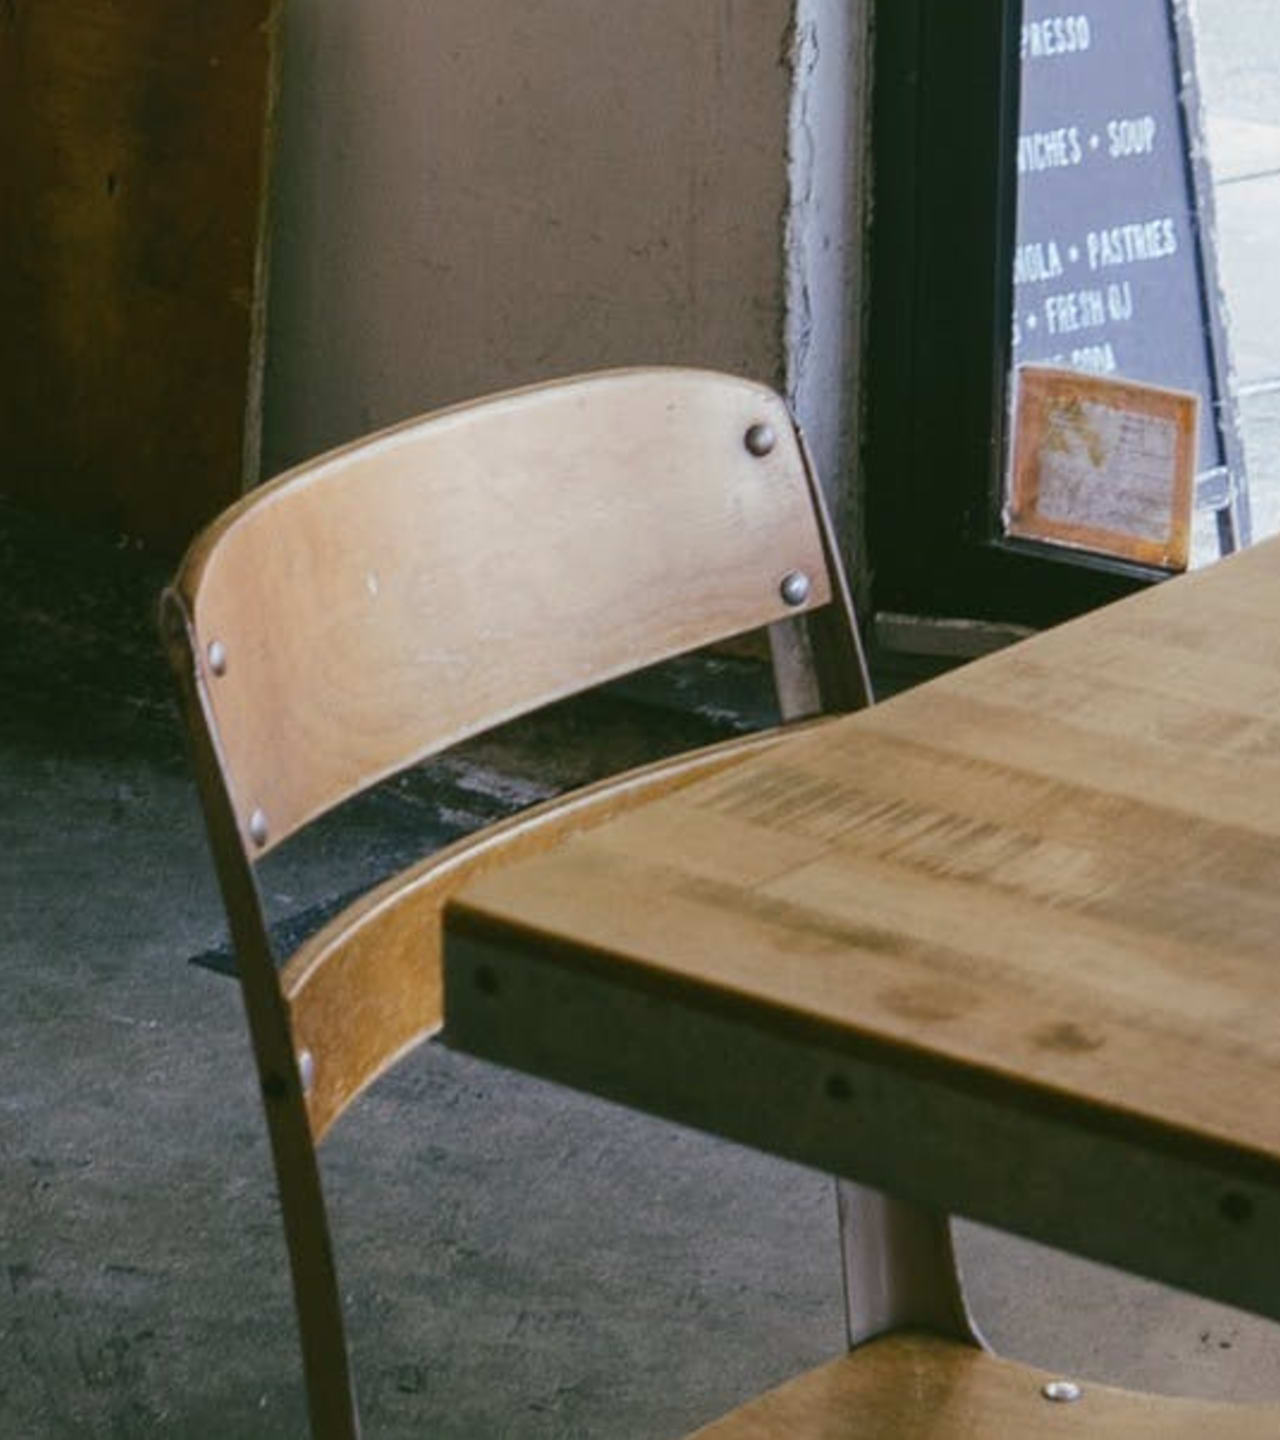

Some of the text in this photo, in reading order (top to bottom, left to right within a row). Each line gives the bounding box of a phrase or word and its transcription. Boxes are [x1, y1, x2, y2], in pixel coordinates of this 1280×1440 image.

[1107, 115, 1156, 158] SOUP
[1085, 216, 1178, 271] PASTRIES
[1045, 290, 1107, 335] FRESH
